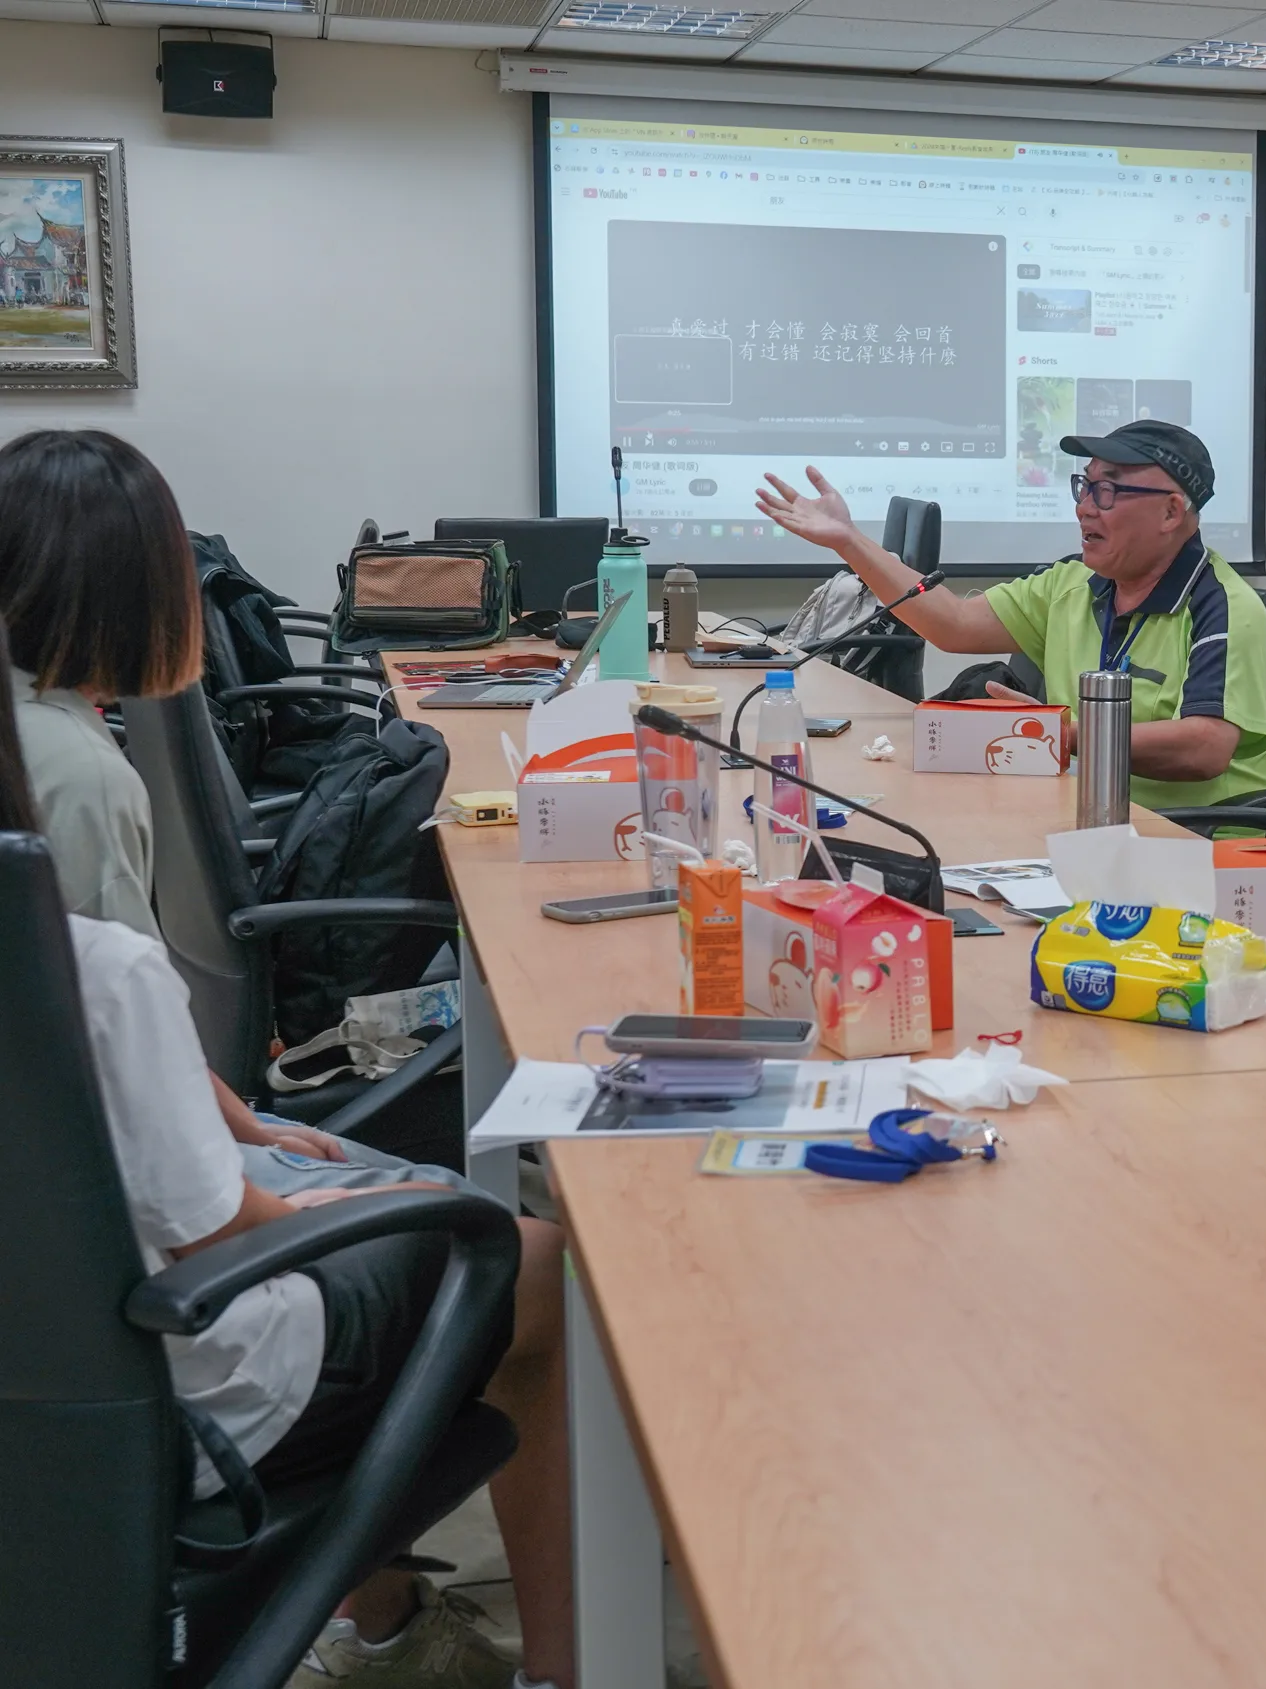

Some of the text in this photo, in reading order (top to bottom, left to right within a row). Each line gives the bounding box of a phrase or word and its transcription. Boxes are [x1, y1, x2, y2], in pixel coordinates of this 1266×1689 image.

[598, 187, 628, 201] YouTube
[1050, 243, 1080, 253] Transcript
[1086, 245, 1116, 255] Summary
[744, 319, 807, 341] 才会懂
[819, 321, 880, 344] 会寂寞
[893, 323, 954, 345] 会回首
[738, 341, 801, 362] 有过错
[1031, 356, 1058, 366] Shorts
[635, 478, 648, 486] GM
[1154, 444, 1210, 501] SPORT
[1065, 964, 1111, 997] 得意
[911, 957, 928, 1045] PABLO
